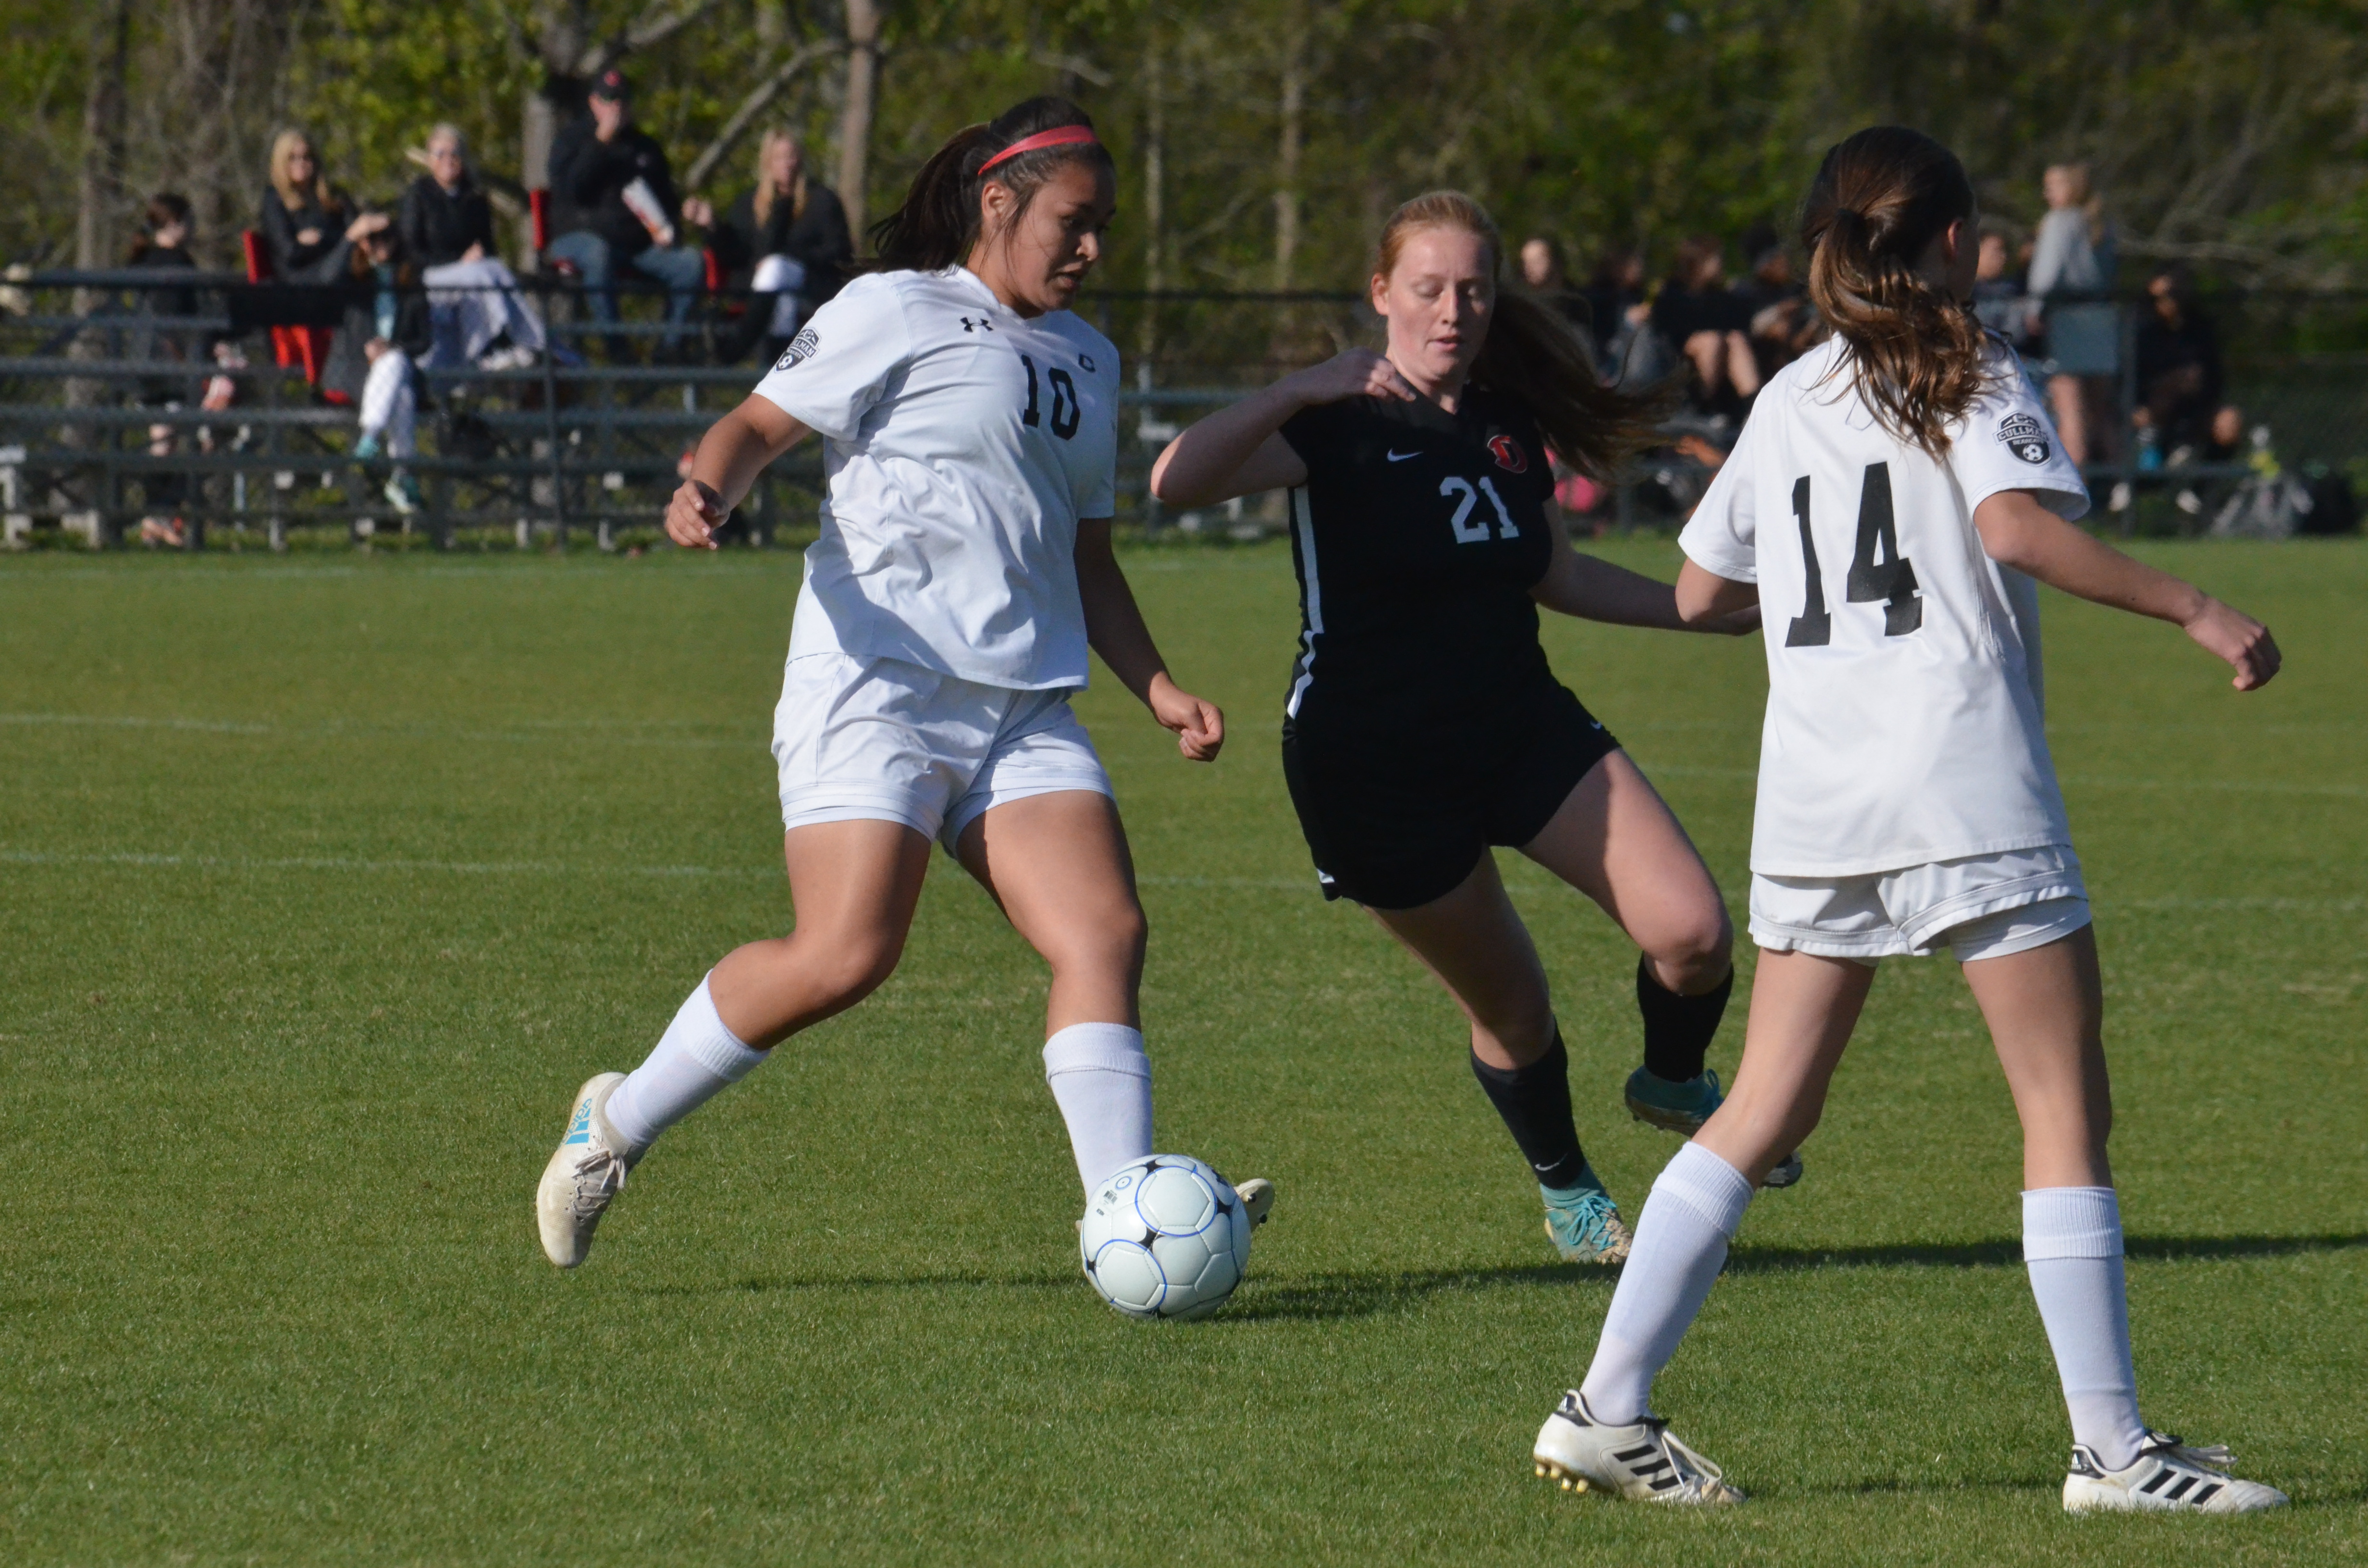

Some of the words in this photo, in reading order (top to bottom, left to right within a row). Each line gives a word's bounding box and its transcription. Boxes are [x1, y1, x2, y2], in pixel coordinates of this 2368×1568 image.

[1021, 354, 1081, 441] 10
[1439, 476, 1519, 544] 21
[1784, 461, 1923, 648] 14
